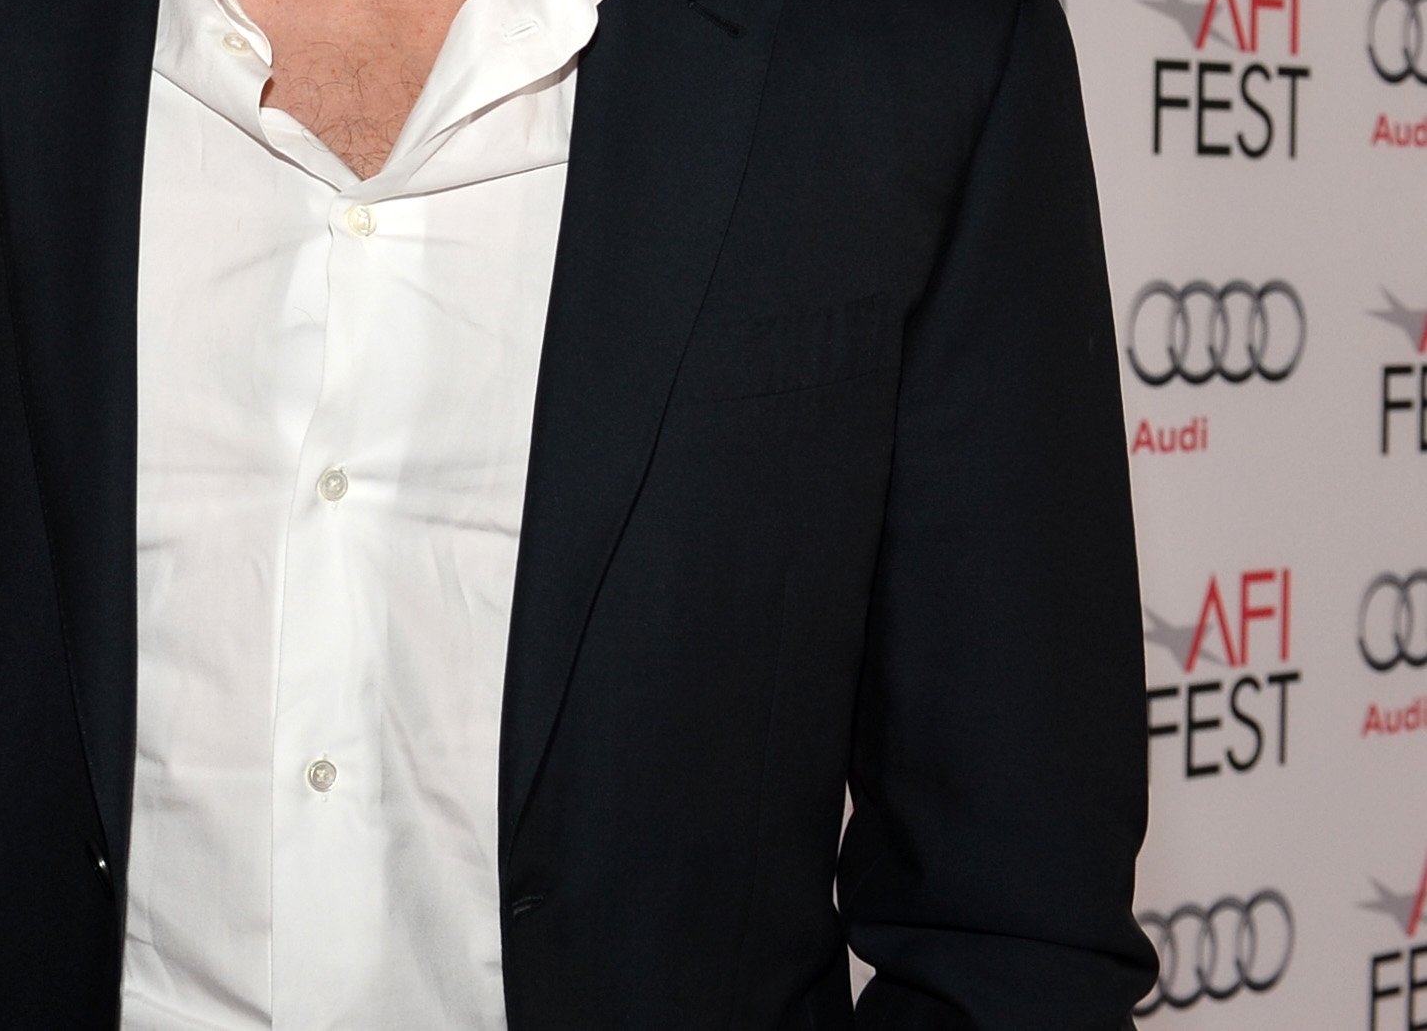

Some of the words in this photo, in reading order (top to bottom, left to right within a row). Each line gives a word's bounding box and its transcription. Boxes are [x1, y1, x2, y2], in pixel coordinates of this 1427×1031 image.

[1153, 59, 1310, 160] FEST
[1131, 419, 1208, 455] Audi
[1184, 569, 1291, 674] AFI
